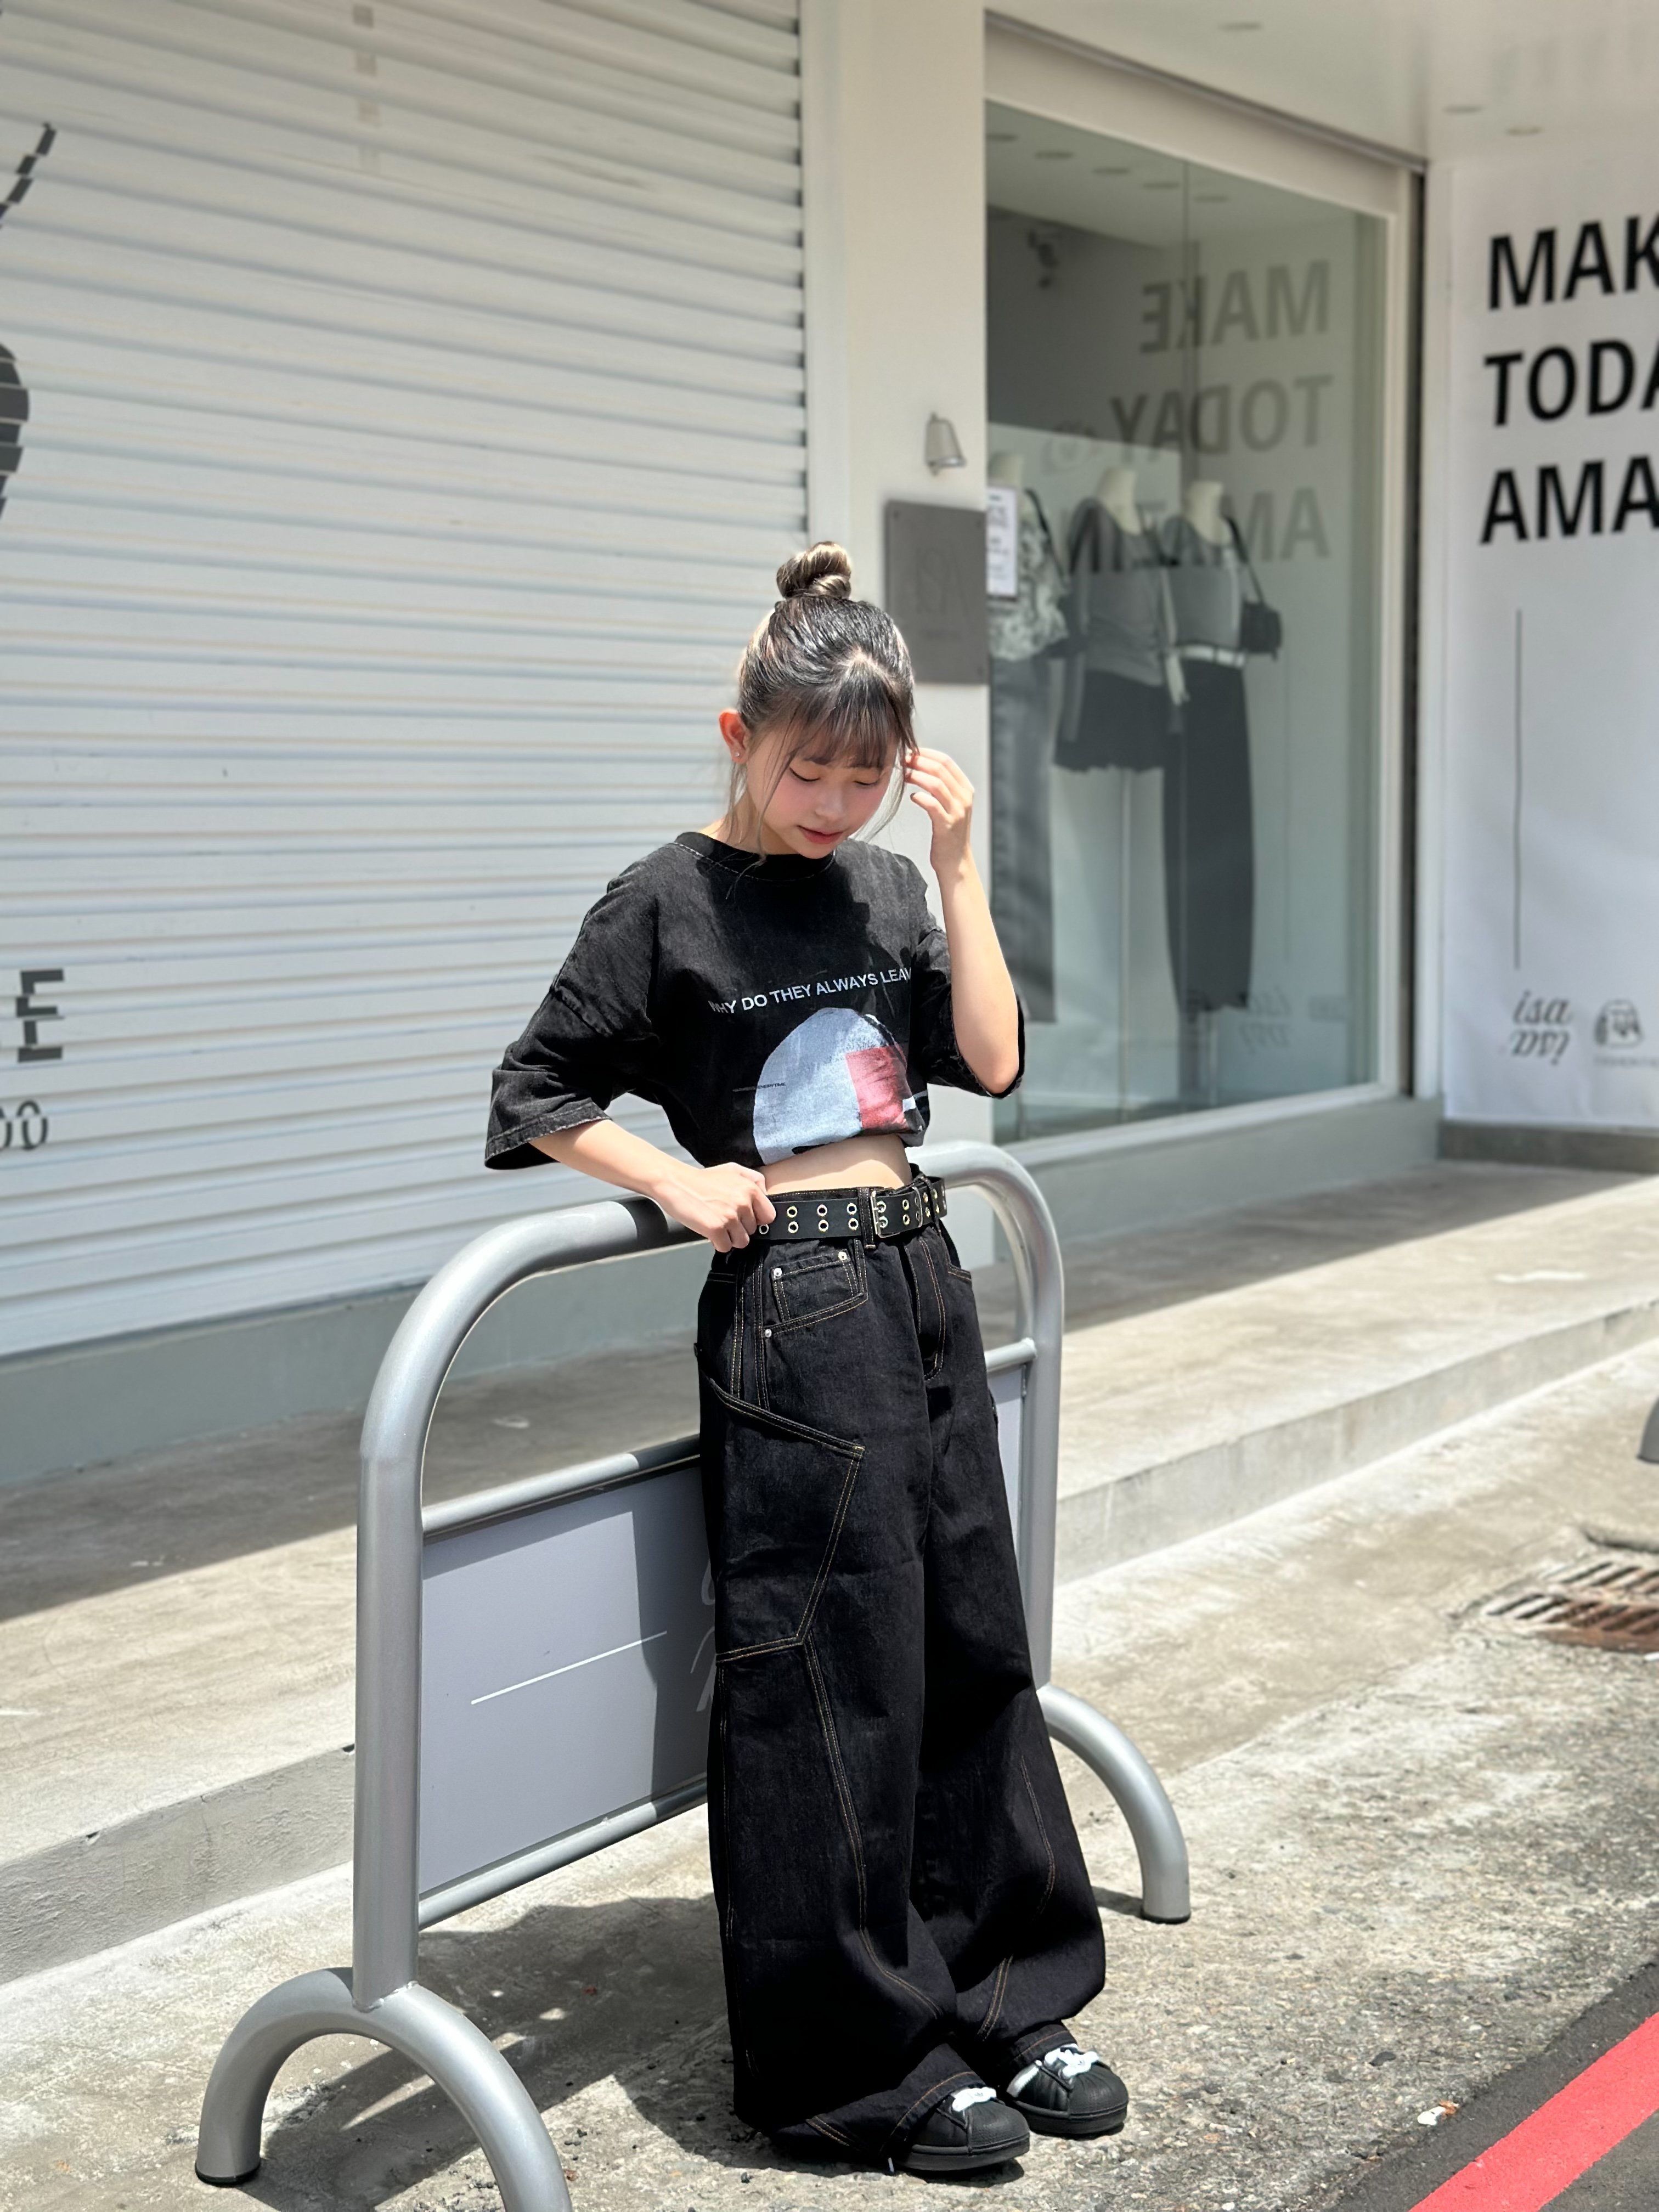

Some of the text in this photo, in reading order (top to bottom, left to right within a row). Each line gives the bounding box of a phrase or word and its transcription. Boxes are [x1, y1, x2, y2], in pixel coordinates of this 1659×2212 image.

[1479, 454, 1659, 546] AMA
[708, 1000, 736, 1013] WHY
[741, 994, 768, 1011] DO
[769, 984, 811, 1003] THEY
[816, 973, 879, 996] ALWAYS
